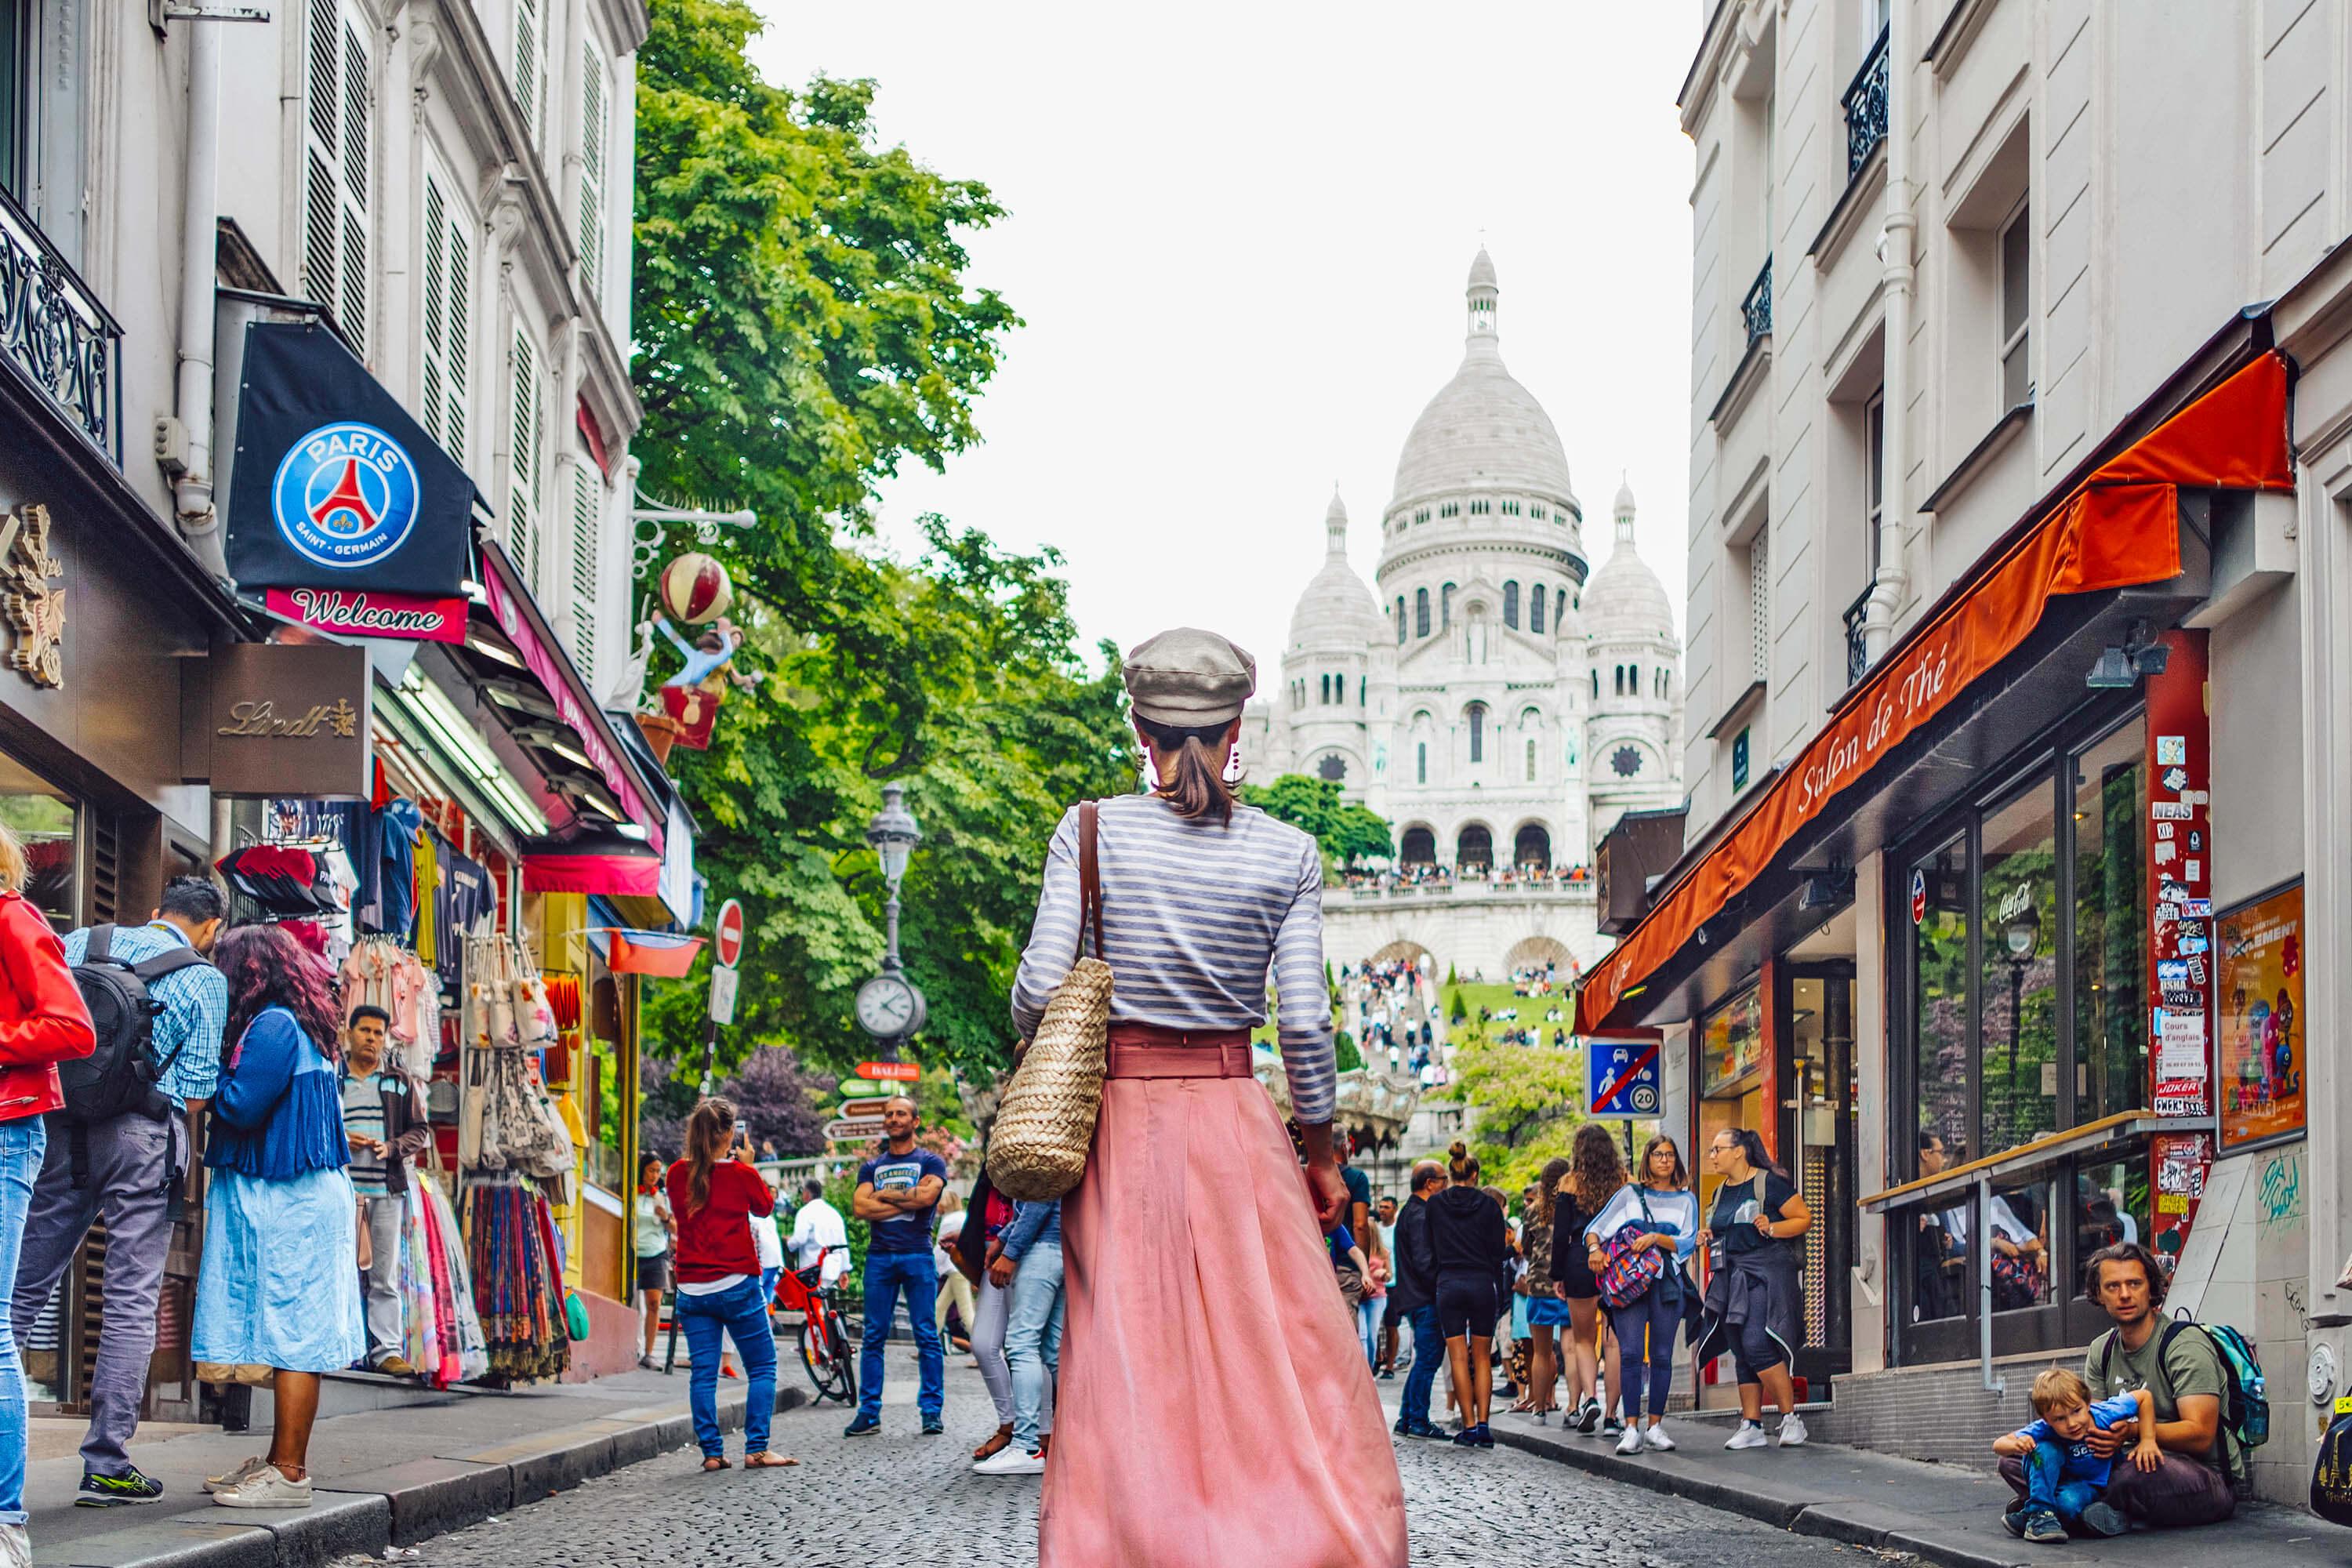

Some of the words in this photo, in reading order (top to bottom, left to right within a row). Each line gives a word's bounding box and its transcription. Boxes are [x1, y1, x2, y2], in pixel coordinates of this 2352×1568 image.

[307, 433, 400, 473] PARIS
[296, 521, 328, 550] SAINT
[334, 532, 389, 556] GERMAIN
[291, 588, 445, 631] Welcome
[217, 701, 331, 738] Lindt
[1798, 736, 1860, 814] Salon
[1866, 691, 1893, 752] de
[1899, 641, 1948, 720] Thé
[1637, 1094, 1653, 1104] 20
[2158, 1083, 2197, 1094] JOKER
